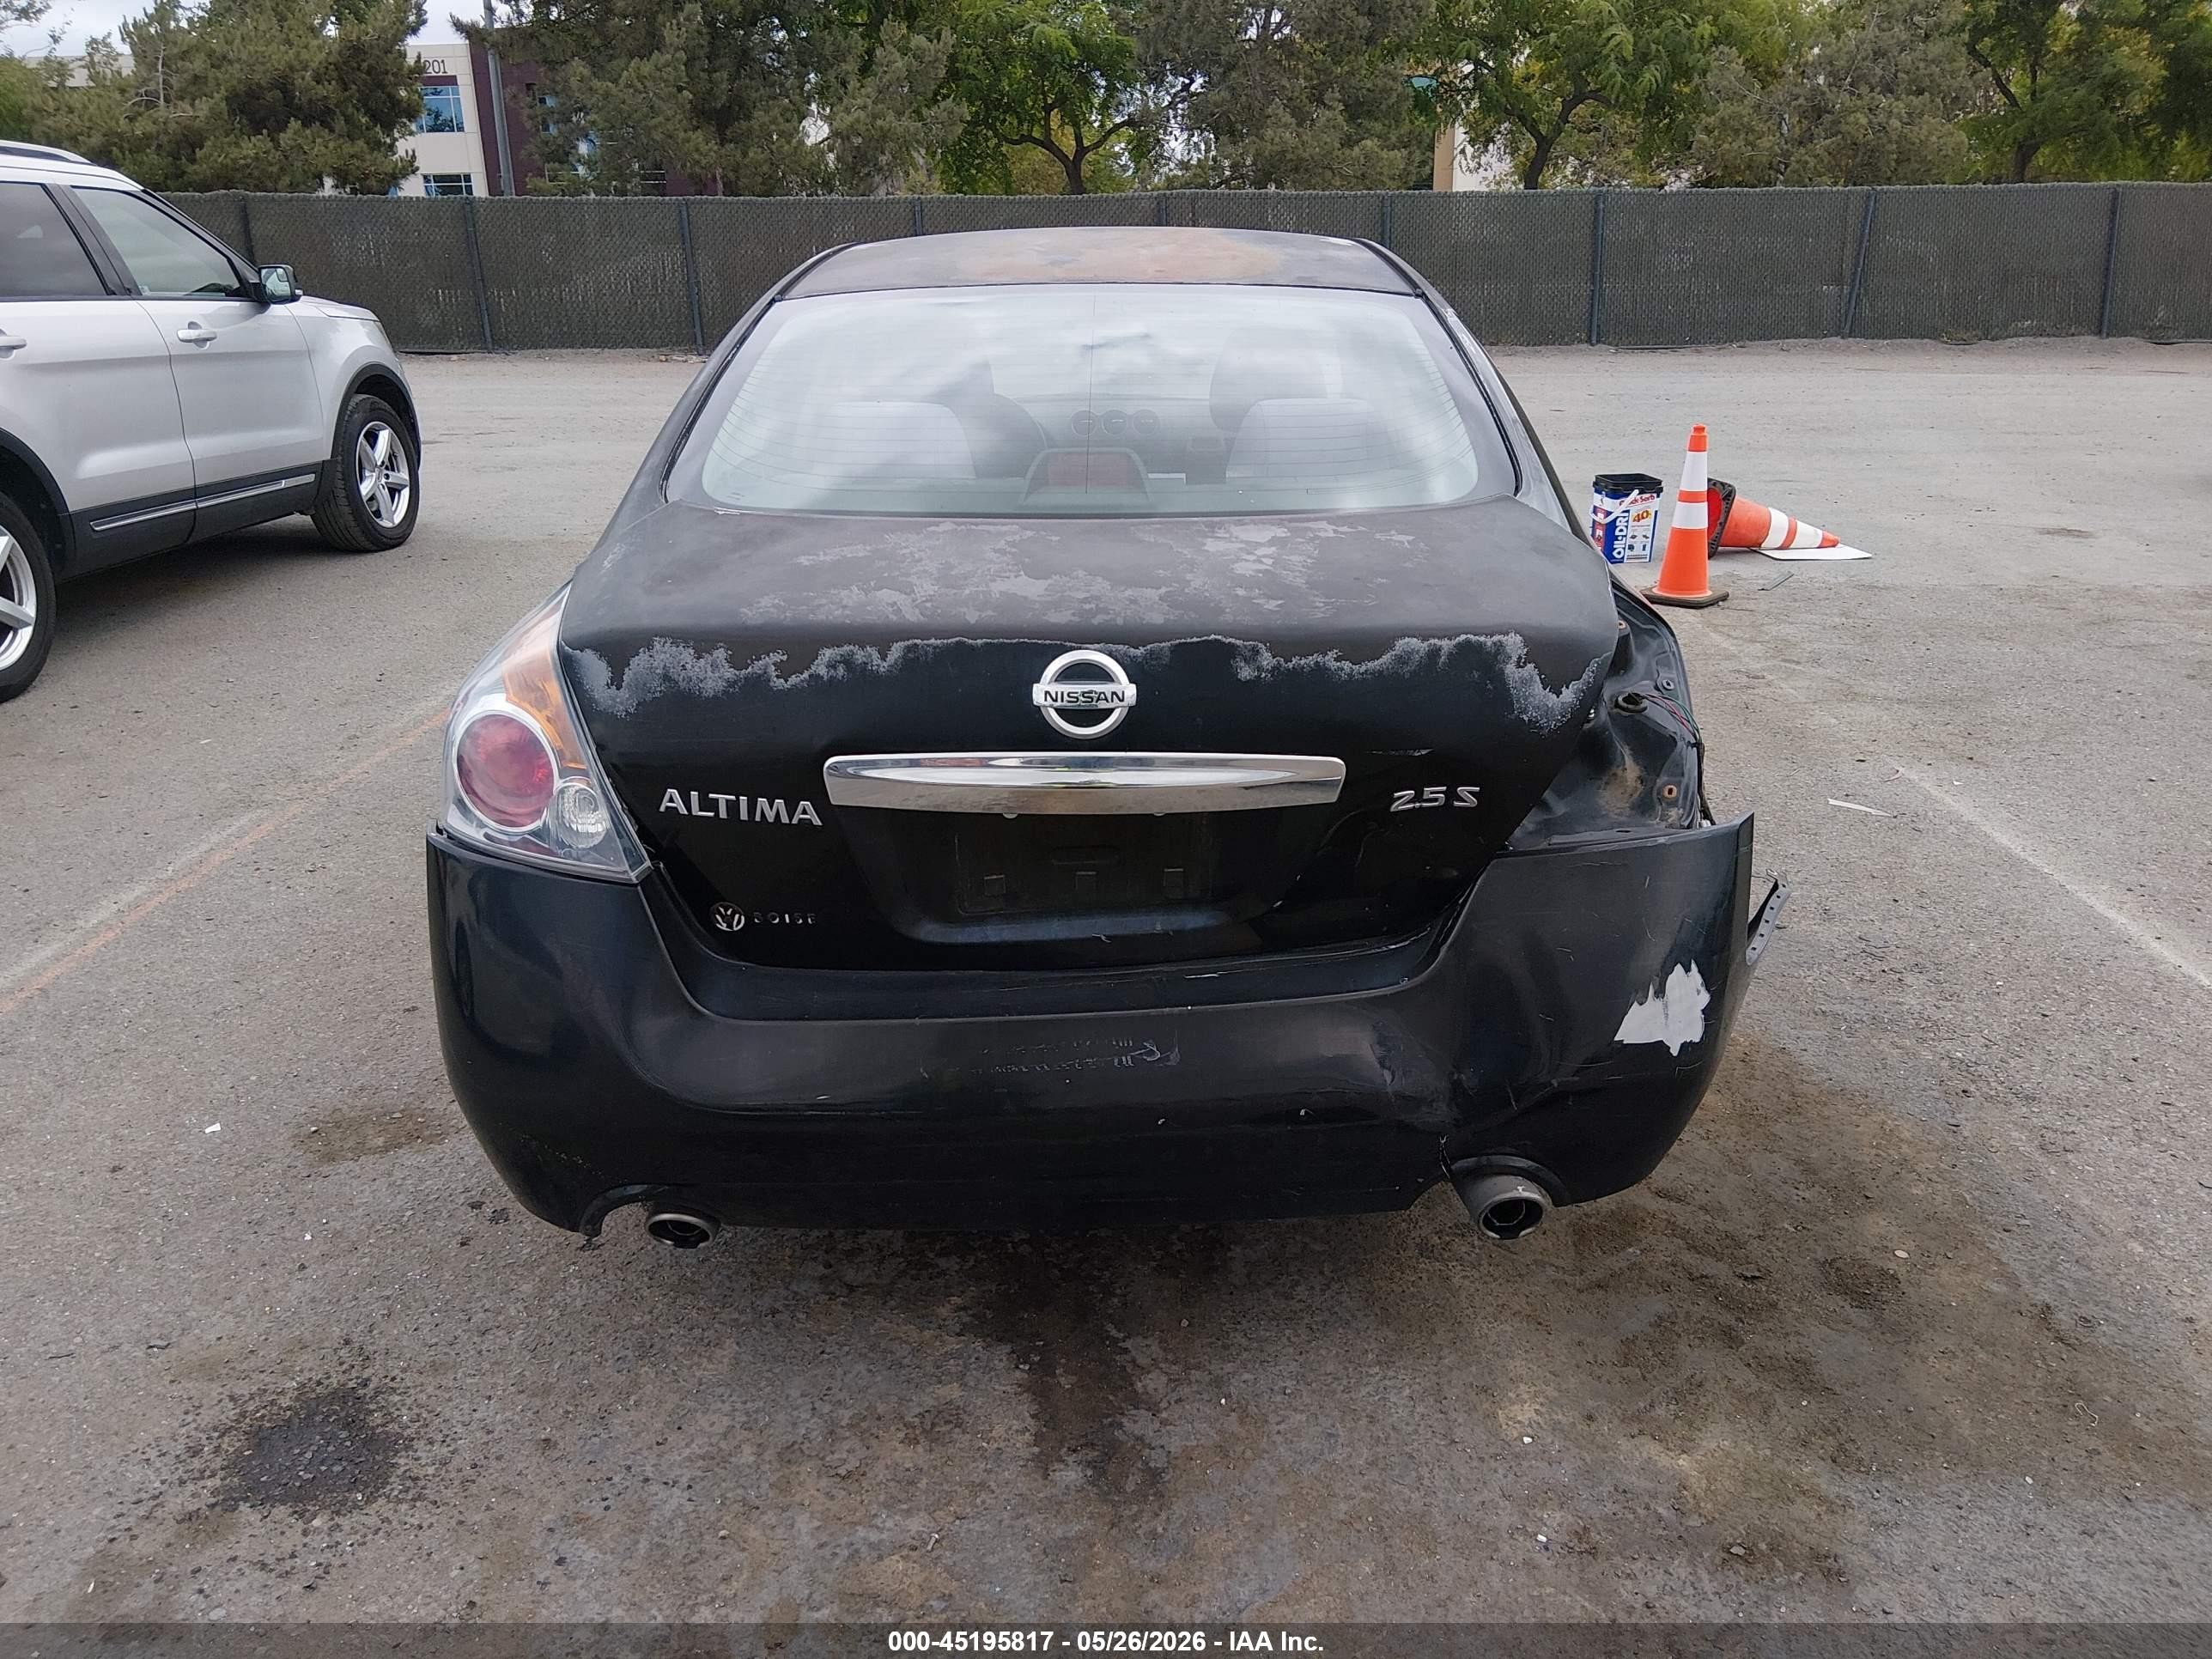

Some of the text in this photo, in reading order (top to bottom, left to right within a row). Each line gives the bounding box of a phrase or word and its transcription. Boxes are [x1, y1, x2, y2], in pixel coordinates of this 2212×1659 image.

[1043, 690, 1125, 704] NISSAN
[659, 787, 823, 827] ALTIMA
[1389, 786, 1480, 812] 2.5 S
